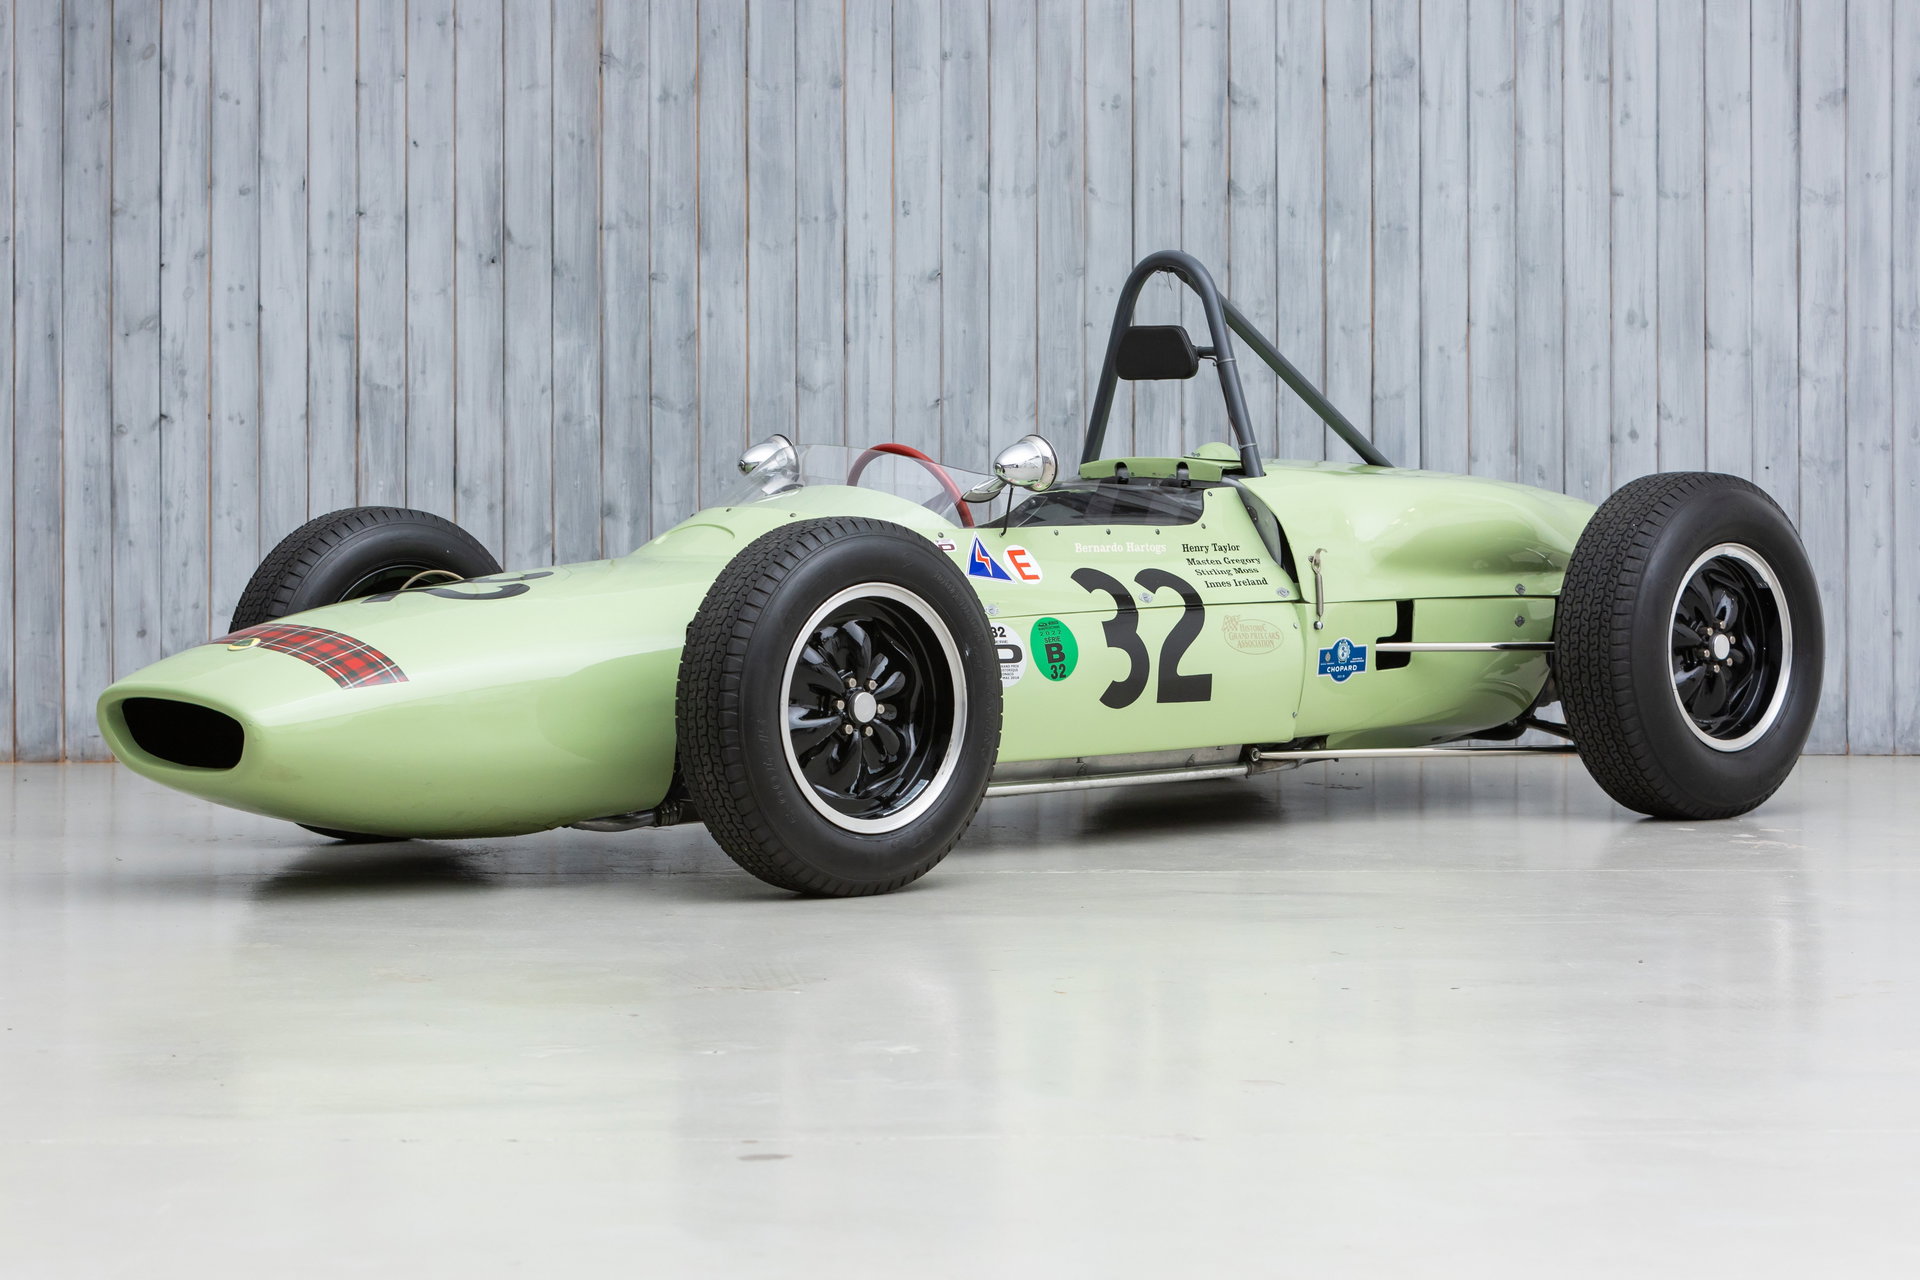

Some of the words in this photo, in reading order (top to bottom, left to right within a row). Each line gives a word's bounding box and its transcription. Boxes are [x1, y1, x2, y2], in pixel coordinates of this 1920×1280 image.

[1074, 542, 1123, 553] Bernardo
[1126, 542, 1167, 555] Hartogs
[1181, 543, 1210, 554] Henry
[1211, 543, 1240, 554] Taylor
[1007, 549, 1040, 580] E
[1186, 557, 1222, 566] Masten
[1223, 556, 1261, 566] Gregory
[1194, 567, 1233, 577] Stirling
[1234, 566, 1259, 575] Moss
[1204, 579, 1232, 588] Innes
[1233, 577, 1269, 587] Ireland
[1070, 567, 1213, 709] 32
[1045, 643, 1066, 664] B
[1050, 663, 1067, 680] 32
[1326, 664, 1358, 673] CHOPARD
